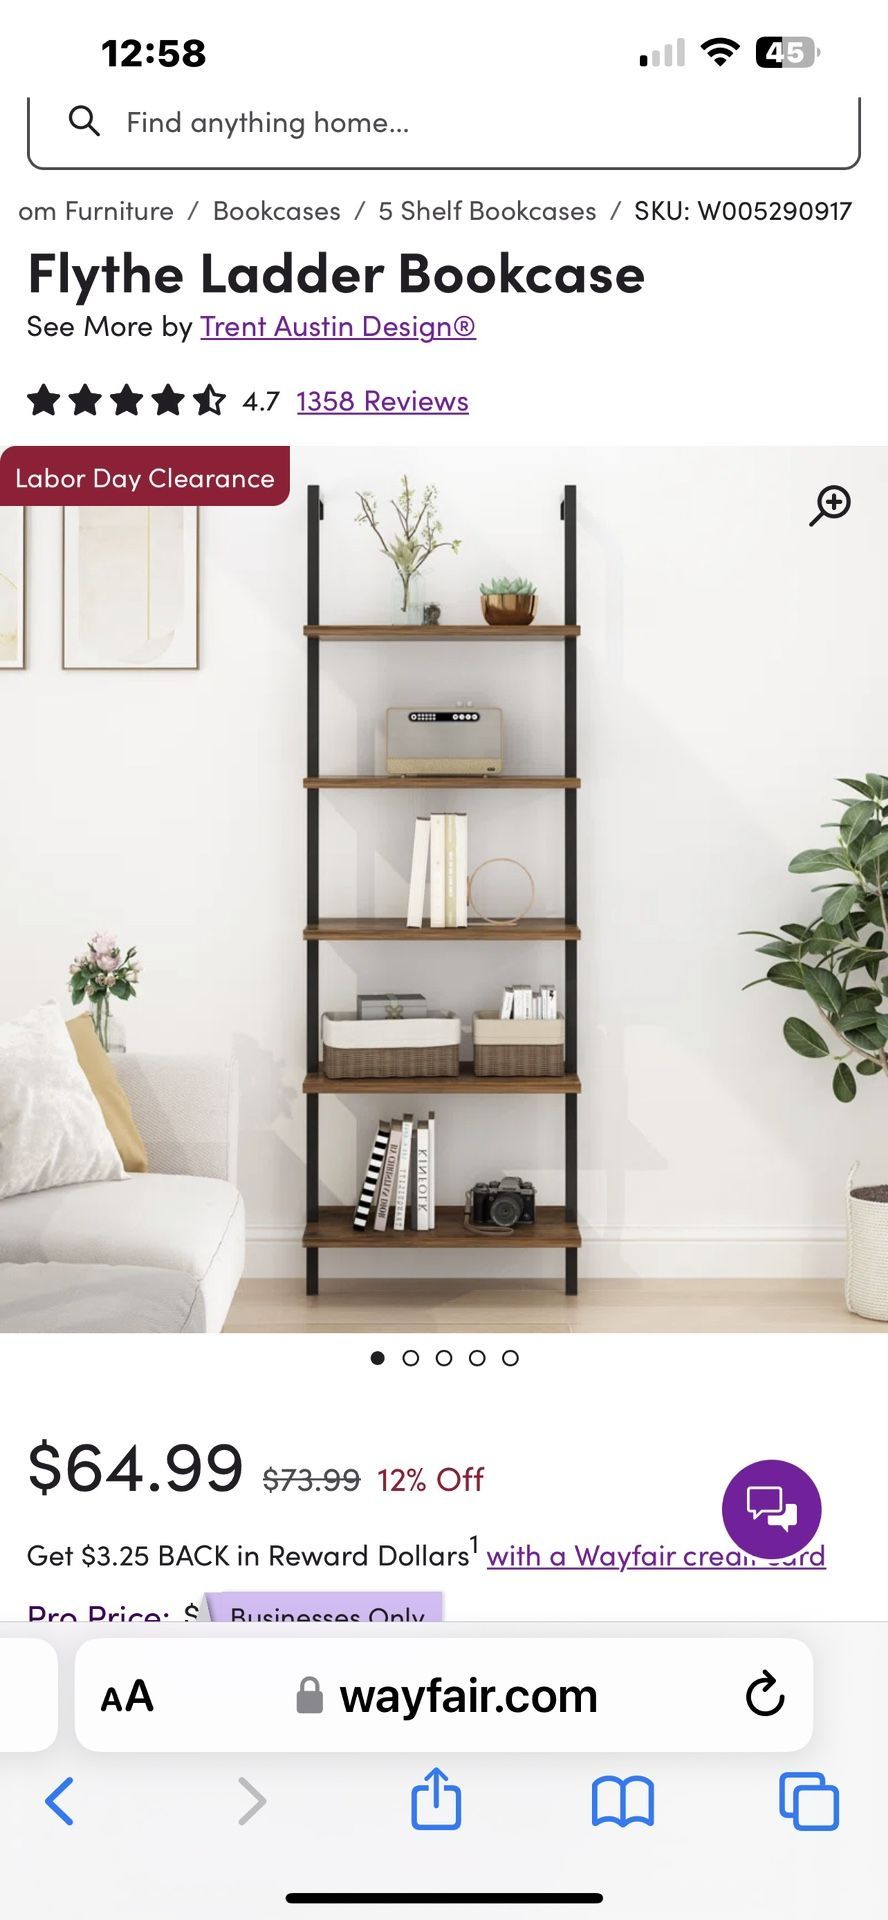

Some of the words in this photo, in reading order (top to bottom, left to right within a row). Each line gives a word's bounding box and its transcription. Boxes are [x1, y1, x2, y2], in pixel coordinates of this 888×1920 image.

[101, 38, 207, 68] 12:58
[765, 41, 805, 64] 45
[127, 110, 181, 133] Find
[190, 110, 305, 140] anything
[314, 110, 409, 134] home...
[18, 206, 56, 221] om
[66, 200, 174, 221] Furniture
[214, 199, 341, 221] Bookcases
[379, 201, 393, 221] 5
[401, 199, 463, 221] Shelf
[470, 199, 597, 221] Bookcases
[634, 200, 690, 221] SKU:
[697, 200, 853, 221] W005290917
[30, 251, 184, 306] Flythe
[202, 251, 386, 294] Ladder
[400, 250, 645, 294] Bookcase
[27, 314, 75, 337] See
[84, 315, 153, 337] More
[162, 314, 193, 344] by
[200, 315, 267, 337] Trent
[273, 315, 353, 337] Austin
[363, 315, 475, 343] Design®
[241, 390, 281, 412] 4.7
[296, 390, 355, 412] 1358
[365, 389, 469, 412] Reviews
[16, 467, 87, 489] Labor
[93, 467, 142, 493] Day
[148, 467, 275, 489] Clearance
[29, 1438, 243, 1497] $64.99
[262, 1465, 362, 1494] $73.99
[377, 1467, 427, 1492] 12%
[436, 1466, 486, 1492] Off
[27, 1544, 74, 1567] Get
[81, 1543, 149, 1569] $3.25
[159, 1544, 230, 1567] BACK
[237, 1544, 259, 1567] in
[269, 1543, 368, 1567] Reward
[486, 1544, 541, 1567] with
[549, 1551, 566, 1567] a
[574, 1544, 677, 1573] Wayfair
[339, 1676, 597, 1722] wayfair.com
